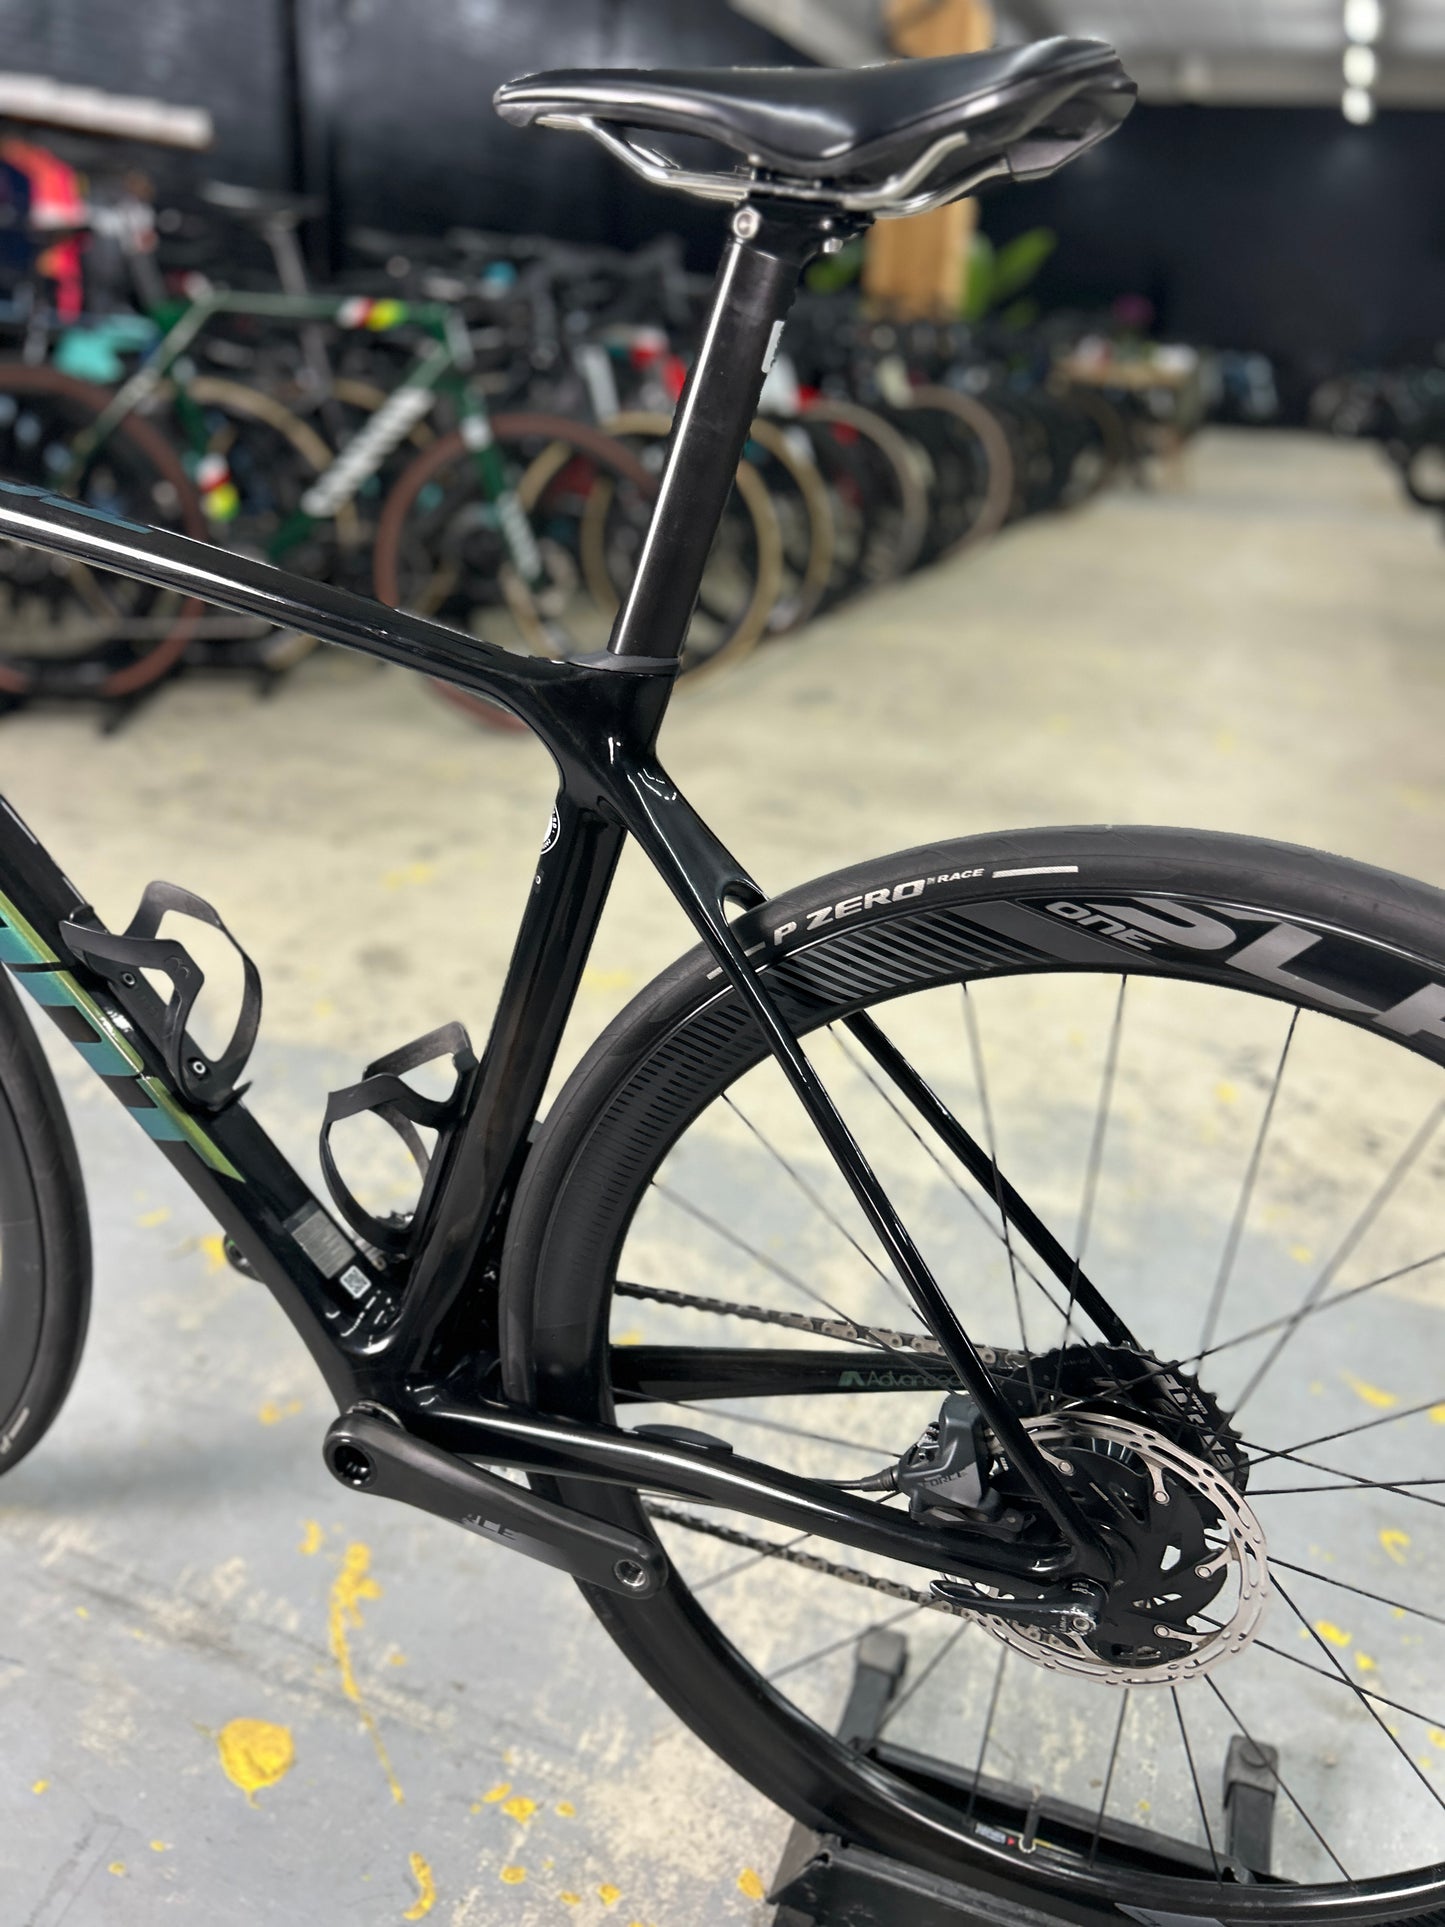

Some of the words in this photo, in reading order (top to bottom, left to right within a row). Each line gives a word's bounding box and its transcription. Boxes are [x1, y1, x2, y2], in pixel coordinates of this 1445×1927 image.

[773, 921, 797, 946] P
[806, 879, 926, 931] ZERO
[937, 868, 985, 883] RACE
